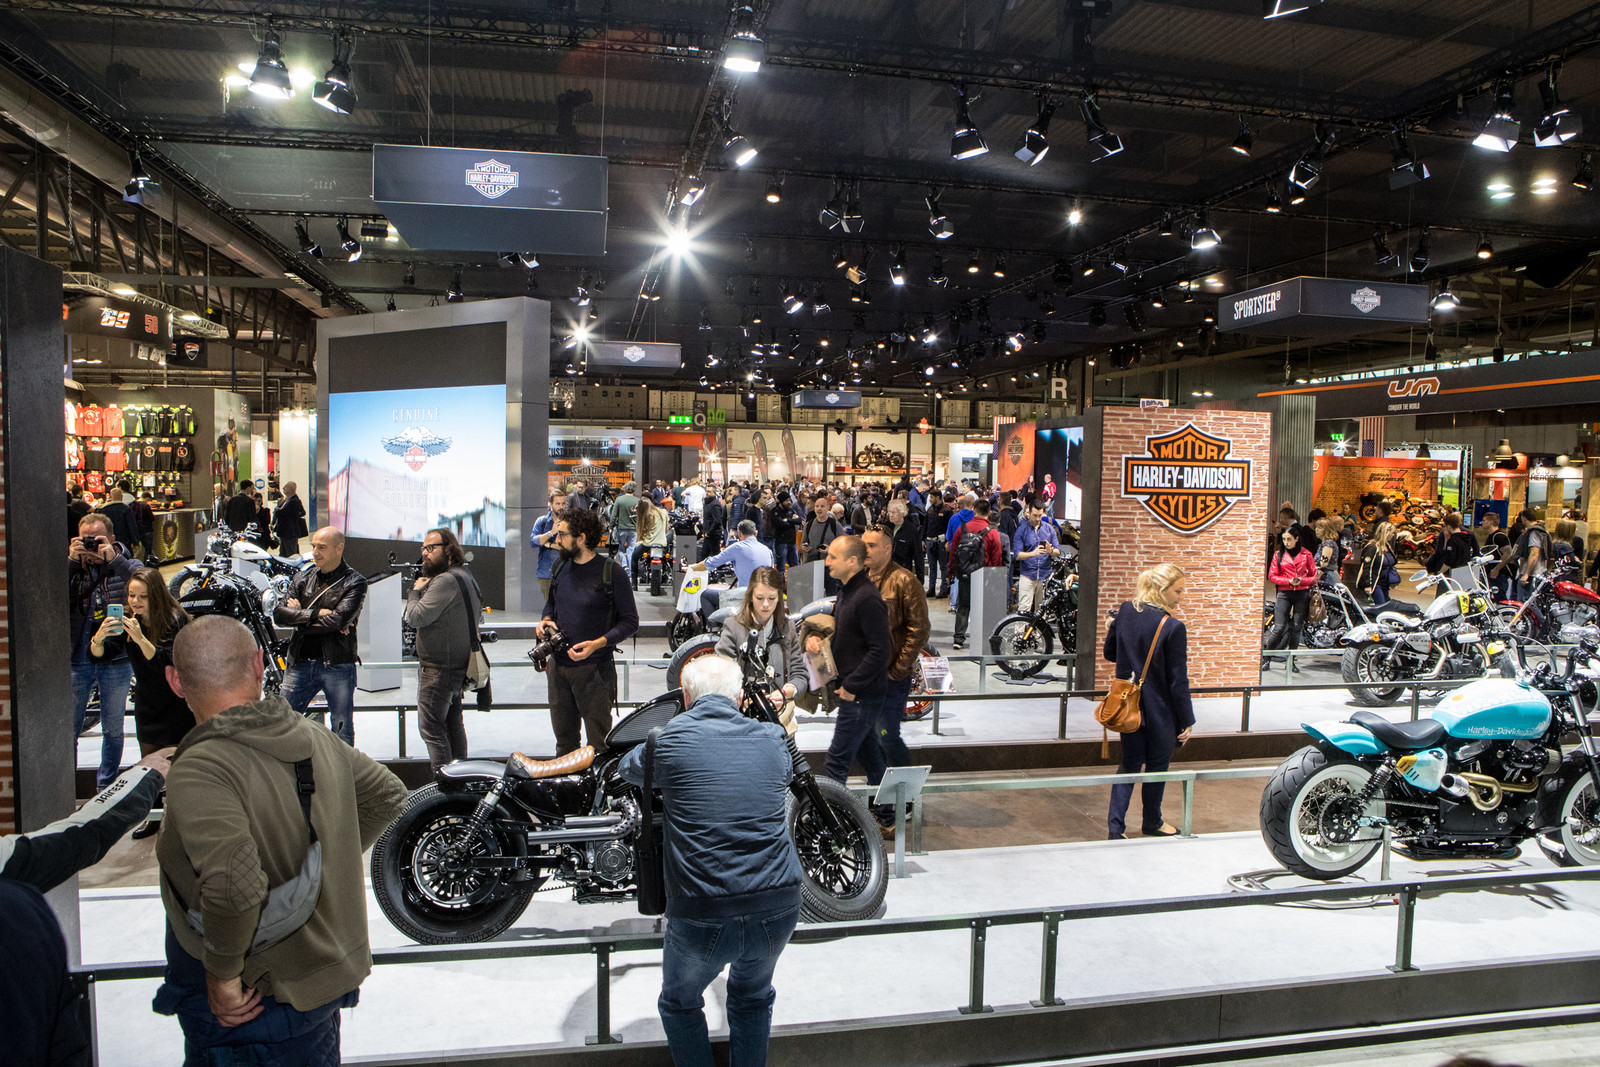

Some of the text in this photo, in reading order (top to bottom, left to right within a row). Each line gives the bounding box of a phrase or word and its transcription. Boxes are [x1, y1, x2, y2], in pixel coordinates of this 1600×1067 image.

[480, 164, 506, 173] MOTOR
[470, 173, 515, 184] HARLEY-DAVIDSON
[480, 185, 505, 195] CYCLES
[1051, 378, 1068, 399] R
[392, 407, 440, 423] GENUINE
[694, 413, 707, 427] Q
[1160, 434, 1219, 460] MOTOR
[1133, 465, 1243, 489] HARLEY-DAVIDSON
[1158, 495, 1217, 524] CYCLES
